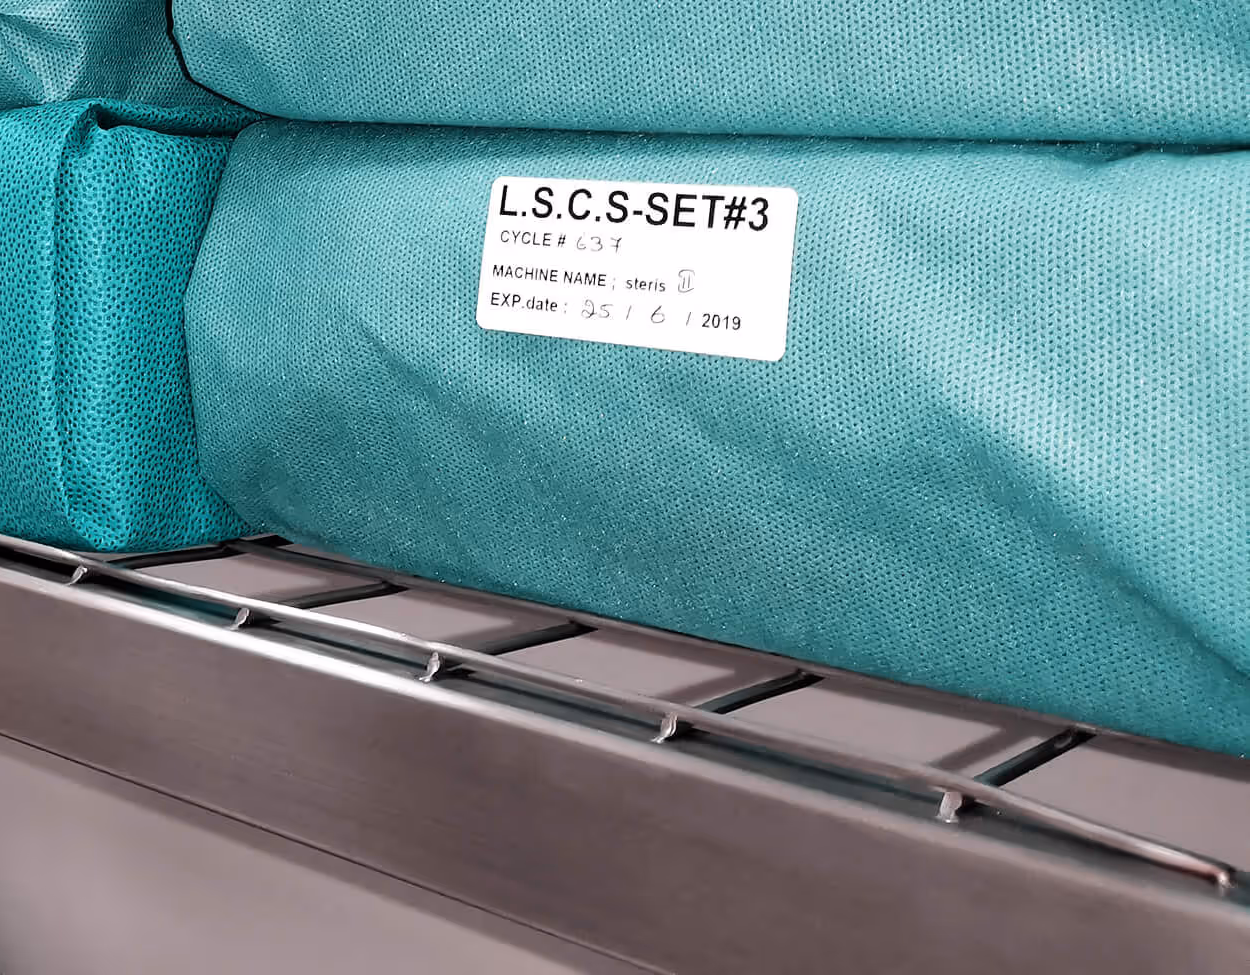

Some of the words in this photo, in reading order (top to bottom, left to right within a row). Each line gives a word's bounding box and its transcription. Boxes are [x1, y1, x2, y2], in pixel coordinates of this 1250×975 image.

[499, 185, 770, 231] L.S.C.S-SET#3
[500, 230, 552, 247] CYCLE
[557, 233, 566, 247] #
[492, 264, 558, 282] MACHINE
[563, 270, 606, 287] NAME
[626, 277, 666, 292] steris
[490, 292, 558, 313] EXP.date
[581, 299, 612, 319] 25
[650, 306, 665, 324] 6
[701, 313, 741, 331] 2019
